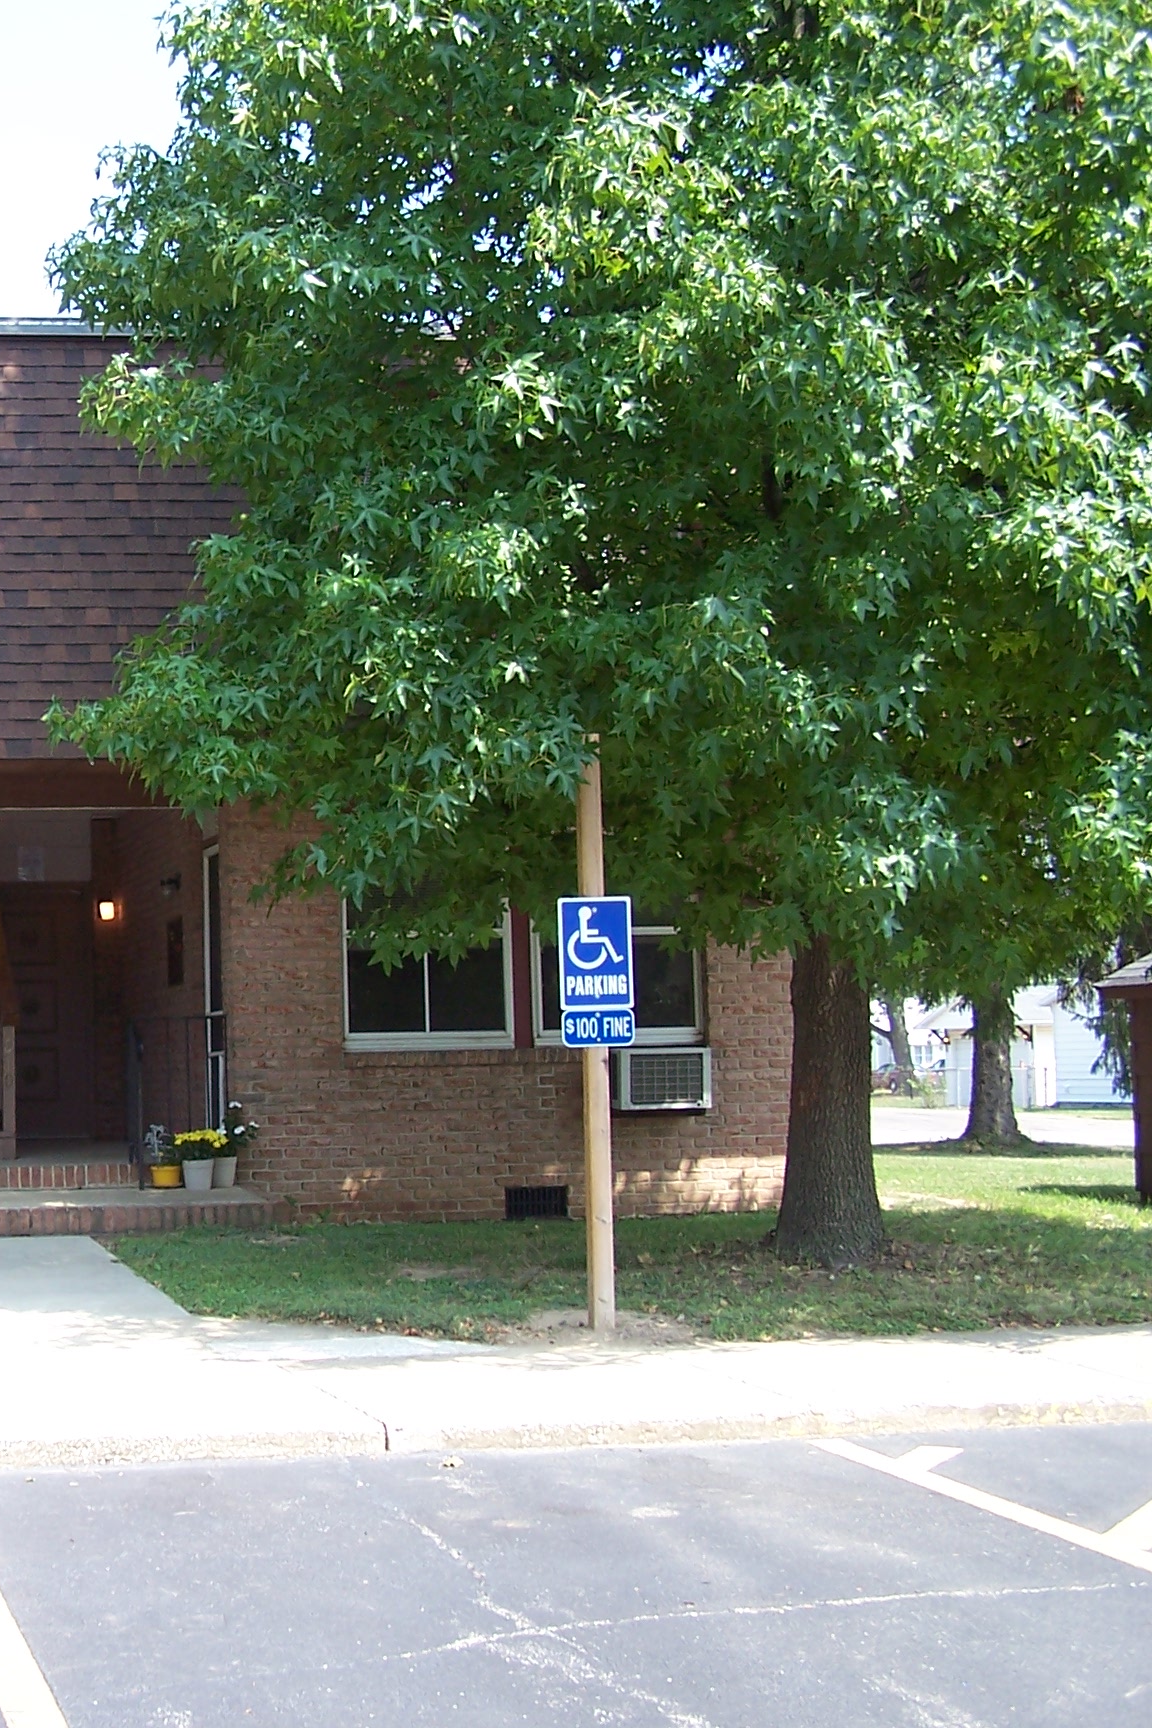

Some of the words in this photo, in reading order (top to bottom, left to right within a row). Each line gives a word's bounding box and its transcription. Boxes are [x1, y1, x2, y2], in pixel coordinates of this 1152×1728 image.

[566, 974, 627, 996] PARKING
[565, 1017, 598, 1038] $100
[603, 1016, 631, 1038] FINE
